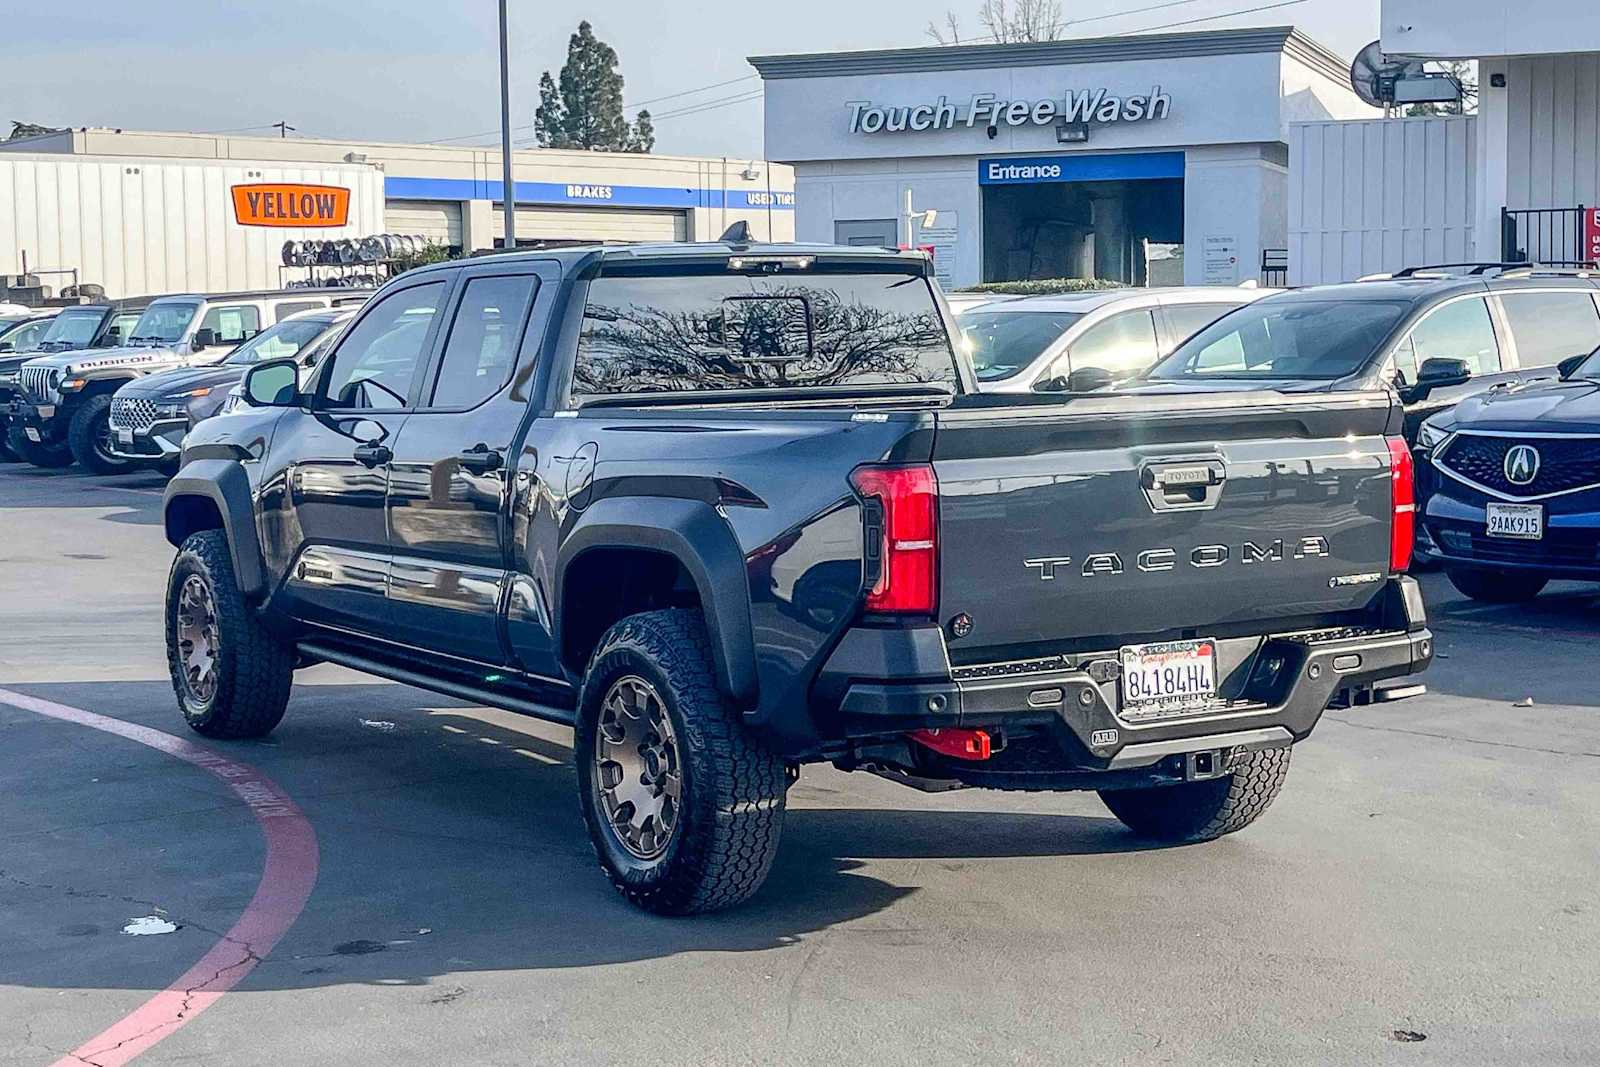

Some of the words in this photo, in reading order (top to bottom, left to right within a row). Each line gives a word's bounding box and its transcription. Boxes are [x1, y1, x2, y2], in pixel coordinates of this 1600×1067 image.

[845, 97, 956, 134] Touch
[966, 93, 1054, 128] Free
[1064, 85, 1171, 124] Wash
[988, 162, 1061, 180] Entrance
[567, 185, 612, 199] BRAKES
[747, 192, 773, 205] USED
[247, 190, 338, 219] YELLOW
[80, 355, 152, 368] RUBICON
[1168, 470, 1207, 481] TOYOTA
[1491, 516, 1538, 533] 9AAK915
[1024, 535, 1329, 580] TACOMA
[1129, 664, 1210, 698] 84184H4
